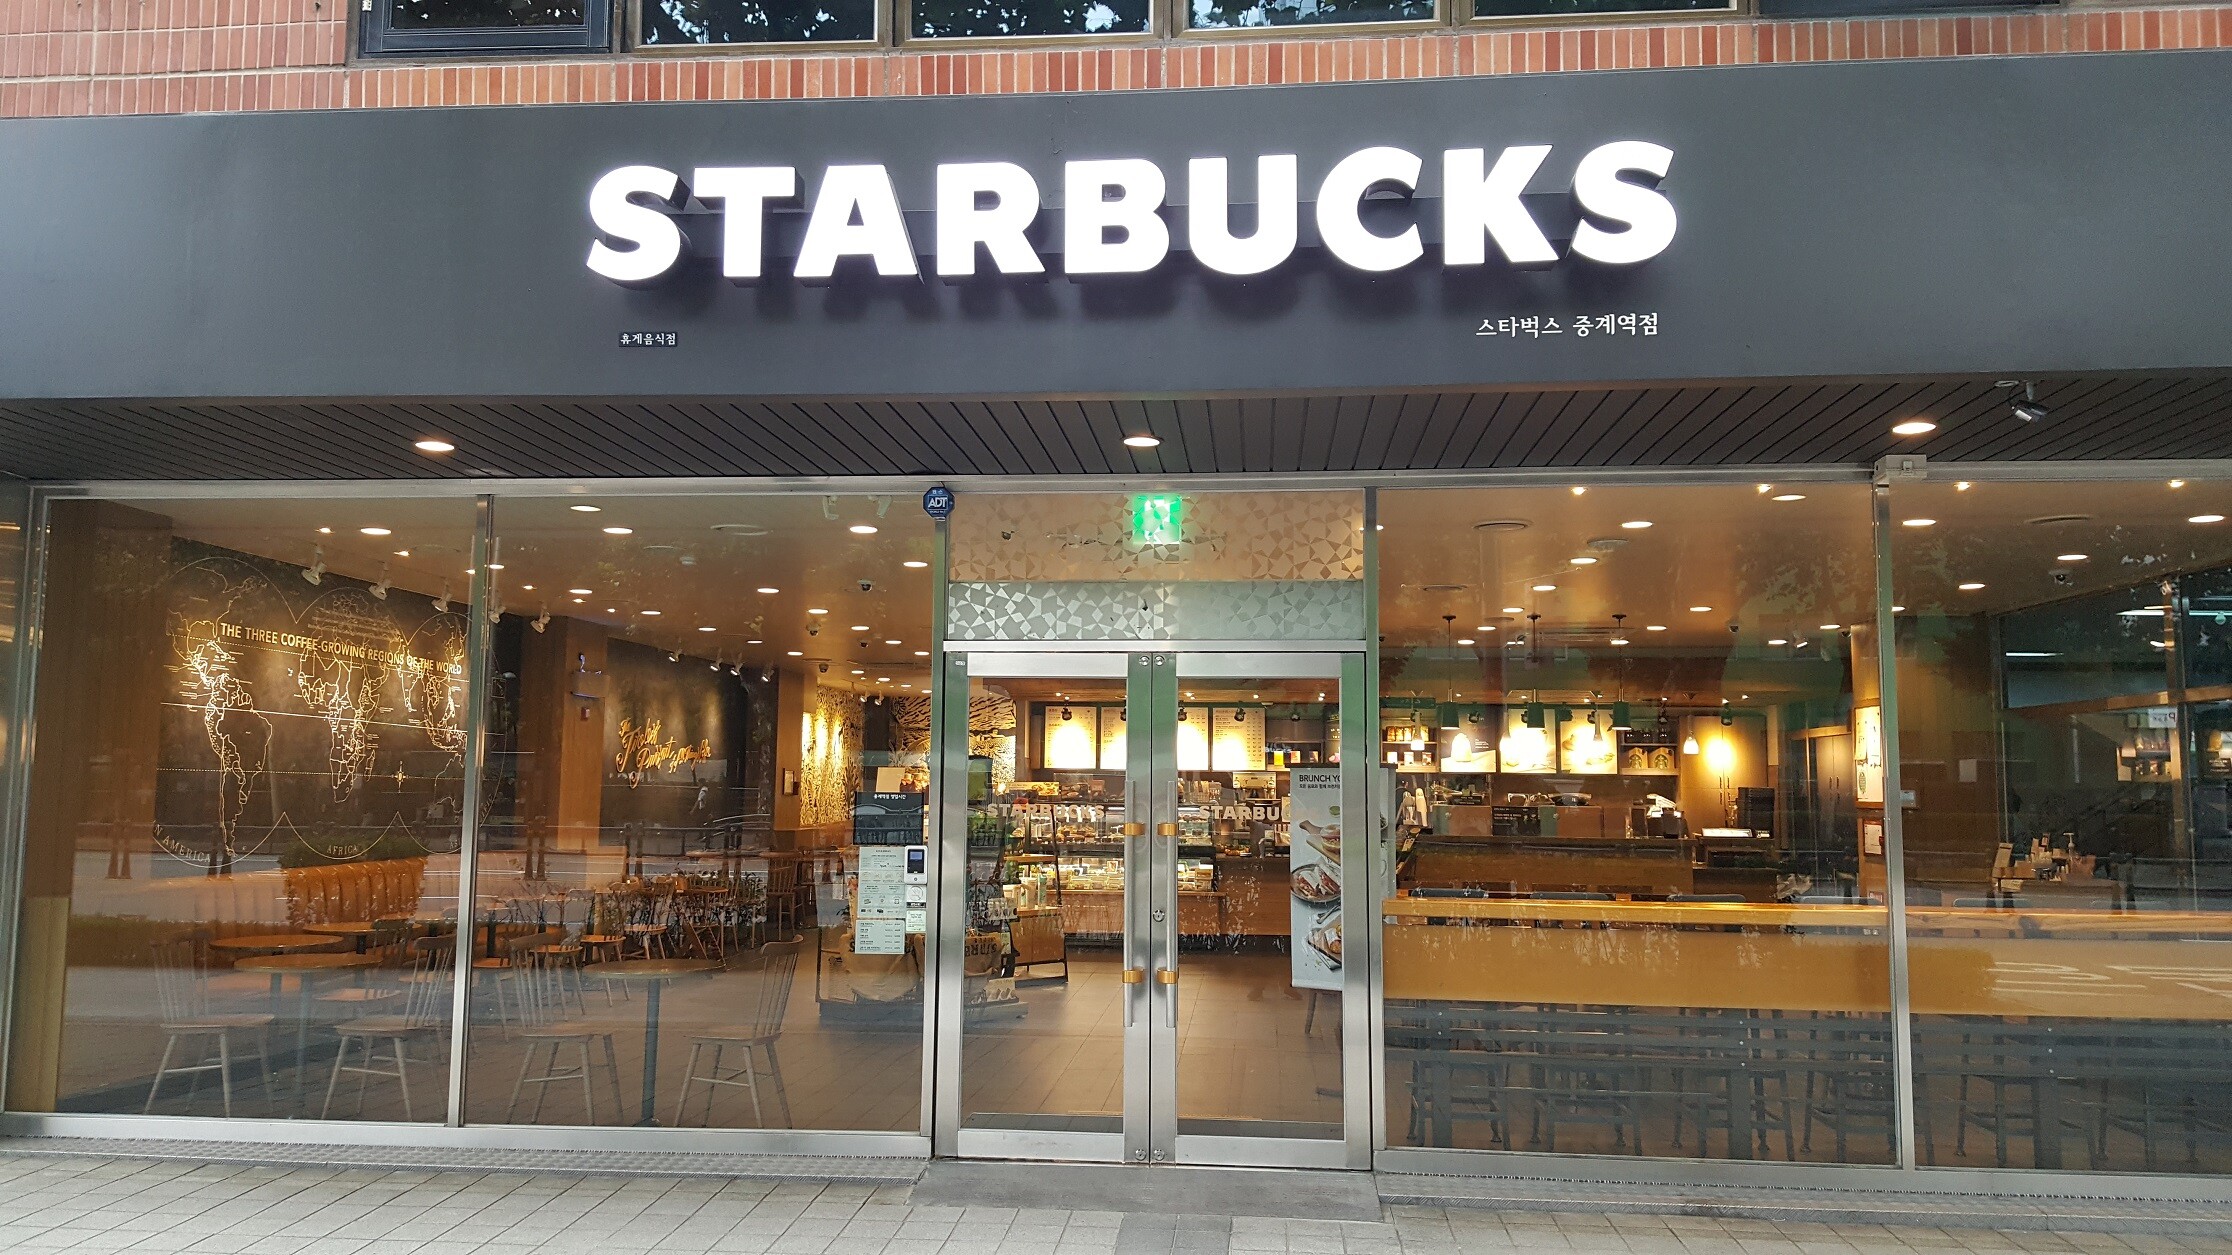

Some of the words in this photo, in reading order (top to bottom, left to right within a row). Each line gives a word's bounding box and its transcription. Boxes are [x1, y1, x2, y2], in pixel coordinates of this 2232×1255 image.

[587, 141, 1676, 280] STARBUCKS
[1475, 316, 1563, 338] 스타벅스
[1572, 312, 1658, 337] 중계역점
[620, 332, 676, 346] 휴게음식점
[928, 497, 948, 508] ADT
[220, 622, 242, 639] THE
[244, 627, 278, 644] THREE
[281, 633, 365, 659] COFFEE-GROWING
[367, 649, 404, 666] REGIONS
[419, 657, 434, 671] THE
[436, 661, 462, 675] WORLD
[1299, 774, 1331, 783] BRUNCH
[987, 803, 1105, 819] STARBUCKS
[1199, 805, 1282, 821] STARBU
[162, 835, 211, 863] AMERICA
[326, 843, 358, 856] AFRICA
